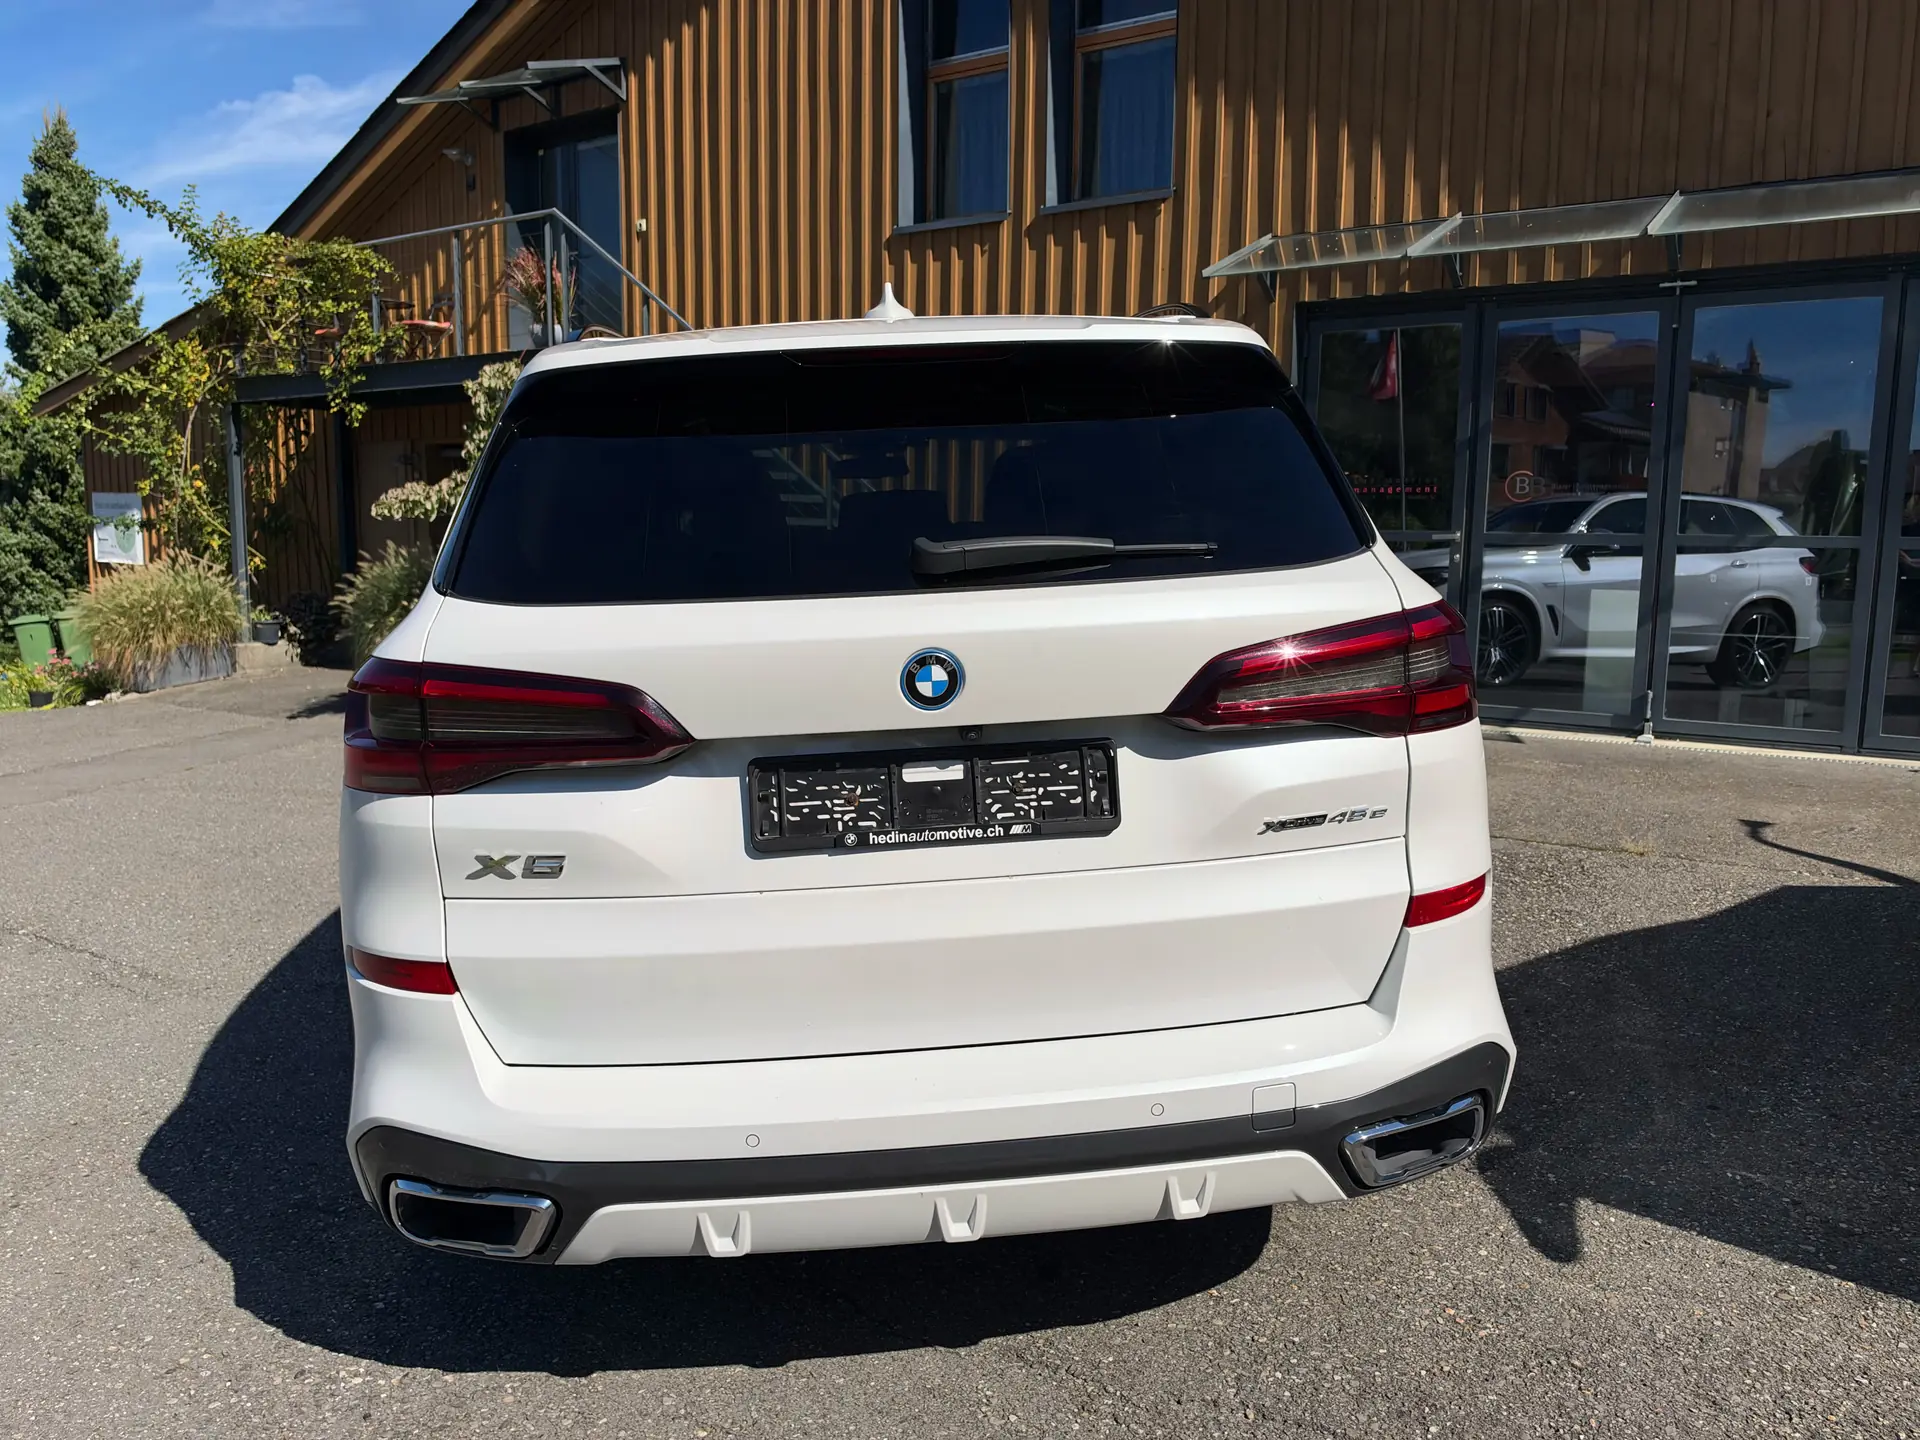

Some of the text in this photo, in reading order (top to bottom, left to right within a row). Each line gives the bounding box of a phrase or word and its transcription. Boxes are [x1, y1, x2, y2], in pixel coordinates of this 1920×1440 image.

[909, 655, 954, 674] BMW
[868, 826, 1005, 845] hedinautomotive.ch
[465, 854, 567, 880] X5
